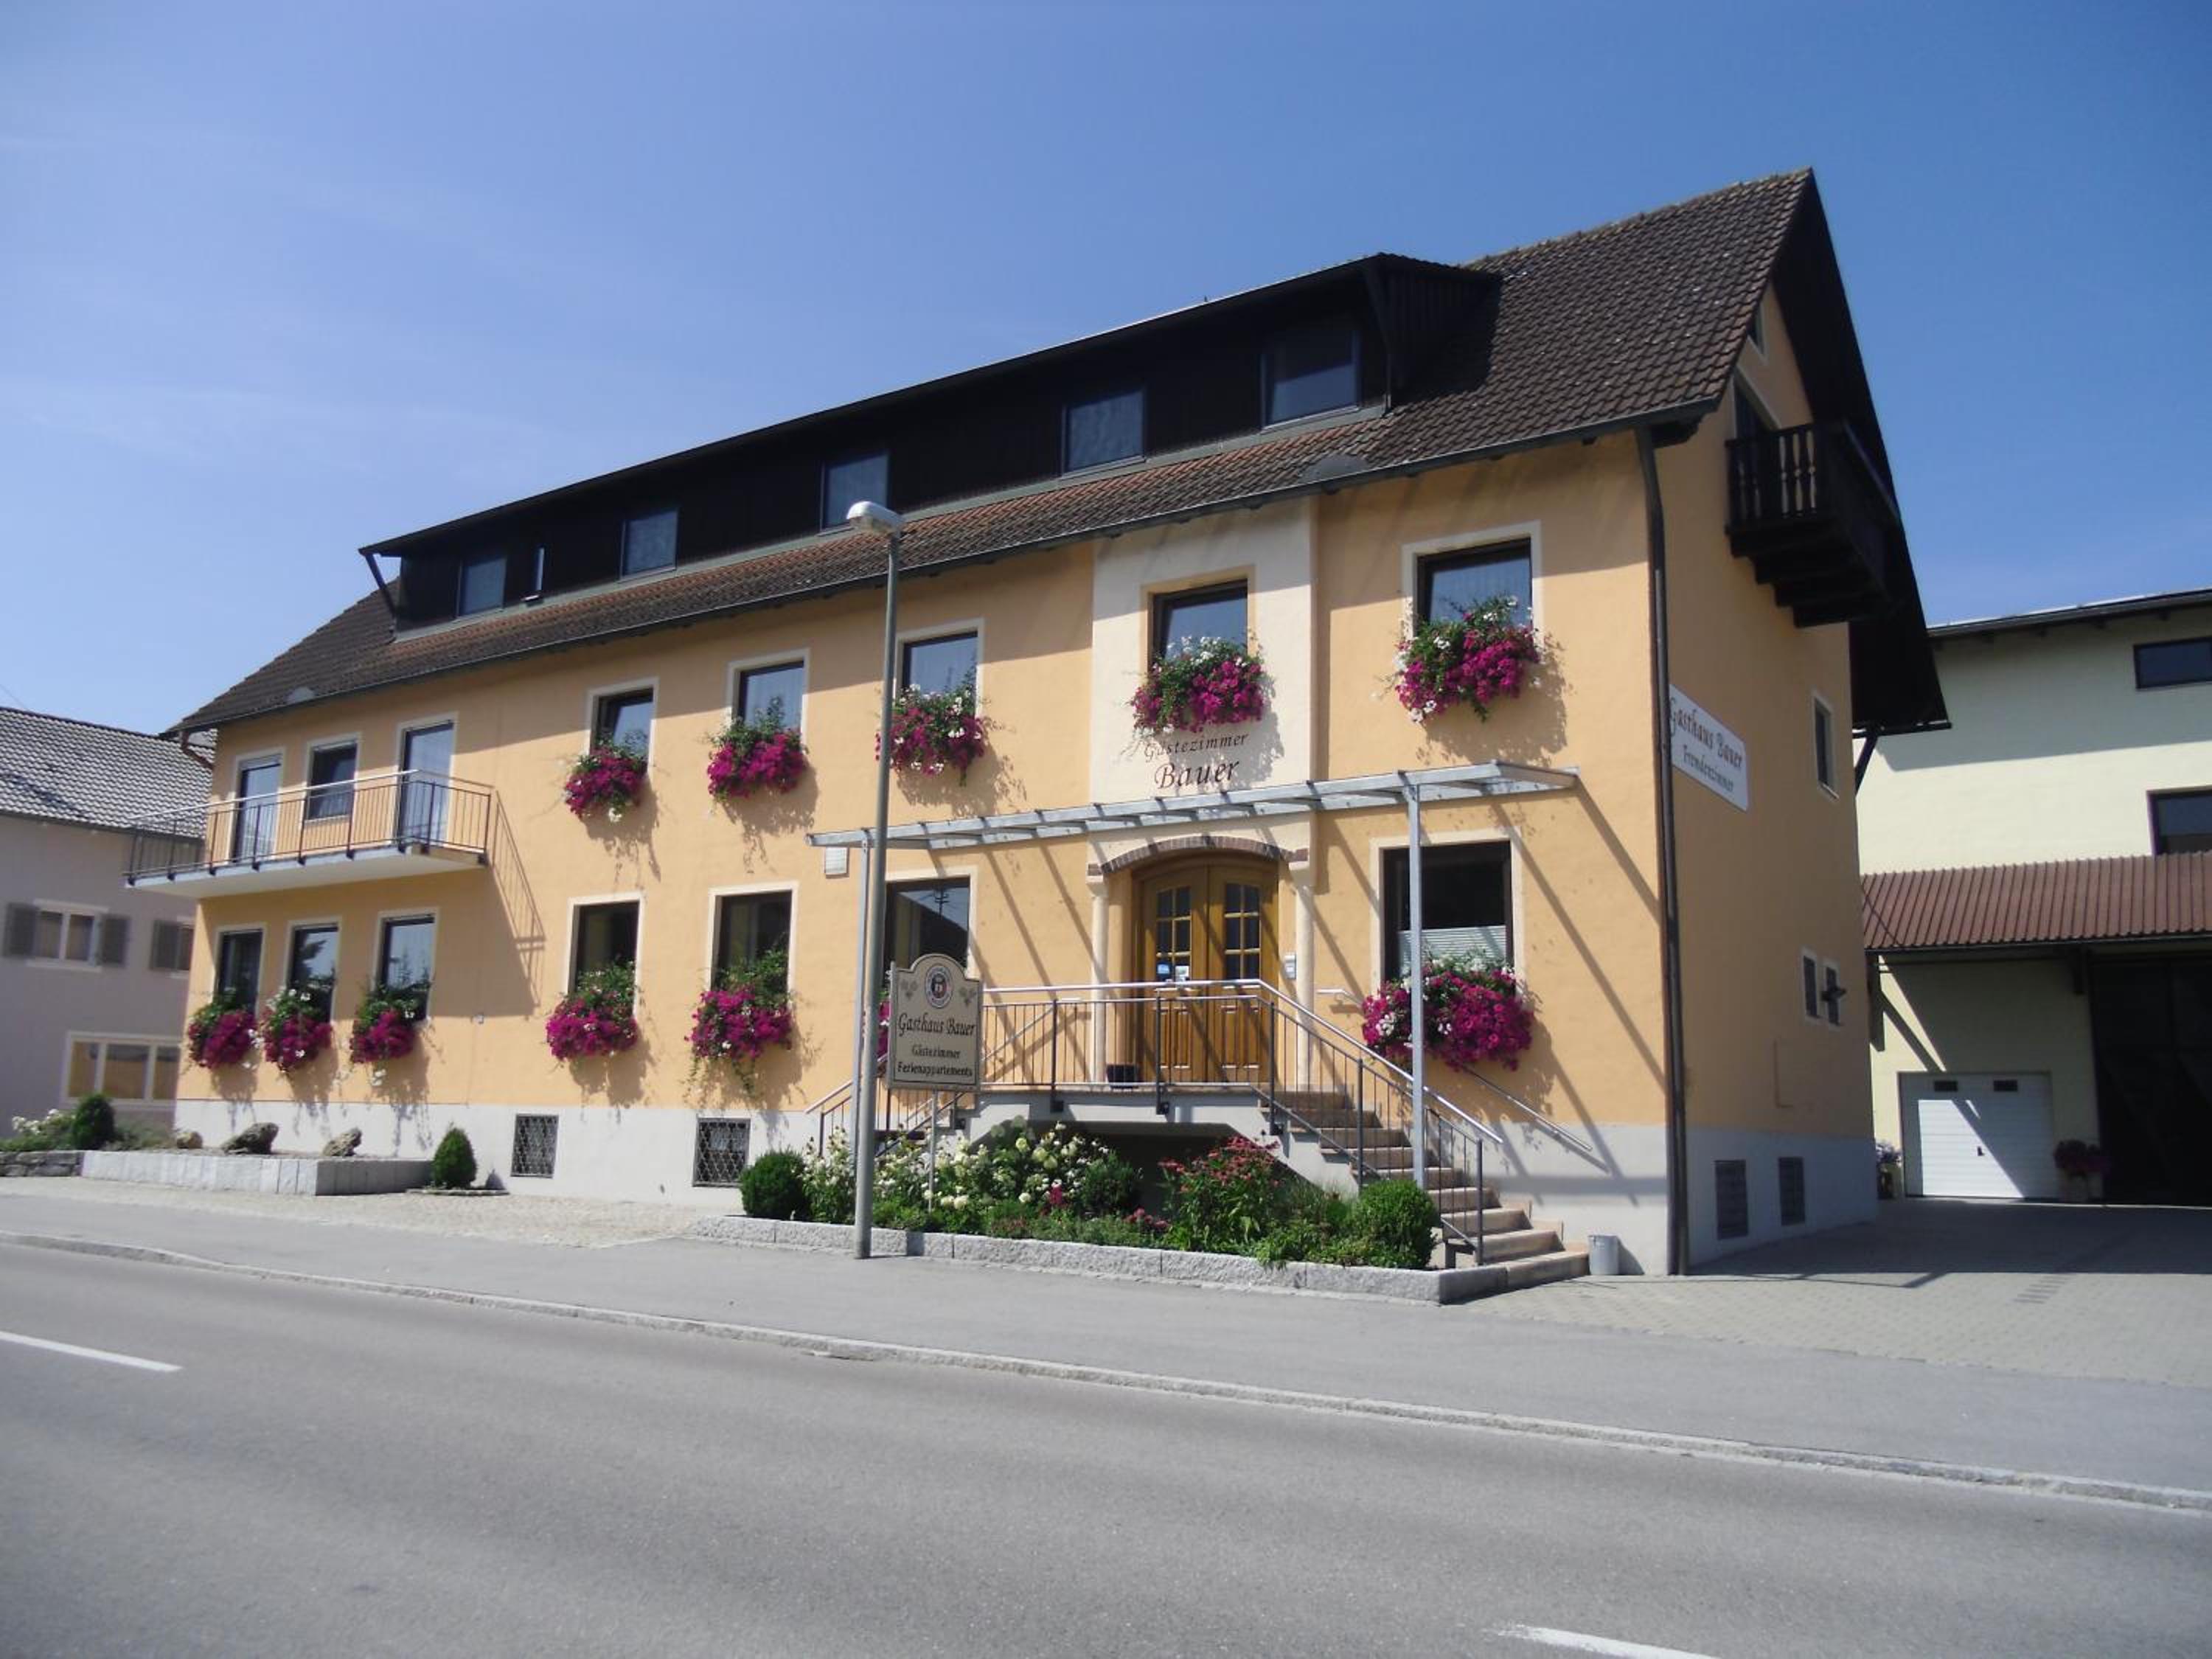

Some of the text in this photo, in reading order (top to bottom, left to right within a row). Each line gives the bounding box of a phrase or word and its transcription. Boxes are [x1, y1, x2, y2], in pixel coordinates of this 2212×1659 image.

[1717, 732, 1743, 768] Bauer
[1154, 760, 1239, 790] Bauer
[898, 1012, 975, 1037] Gasthaus Bauer
